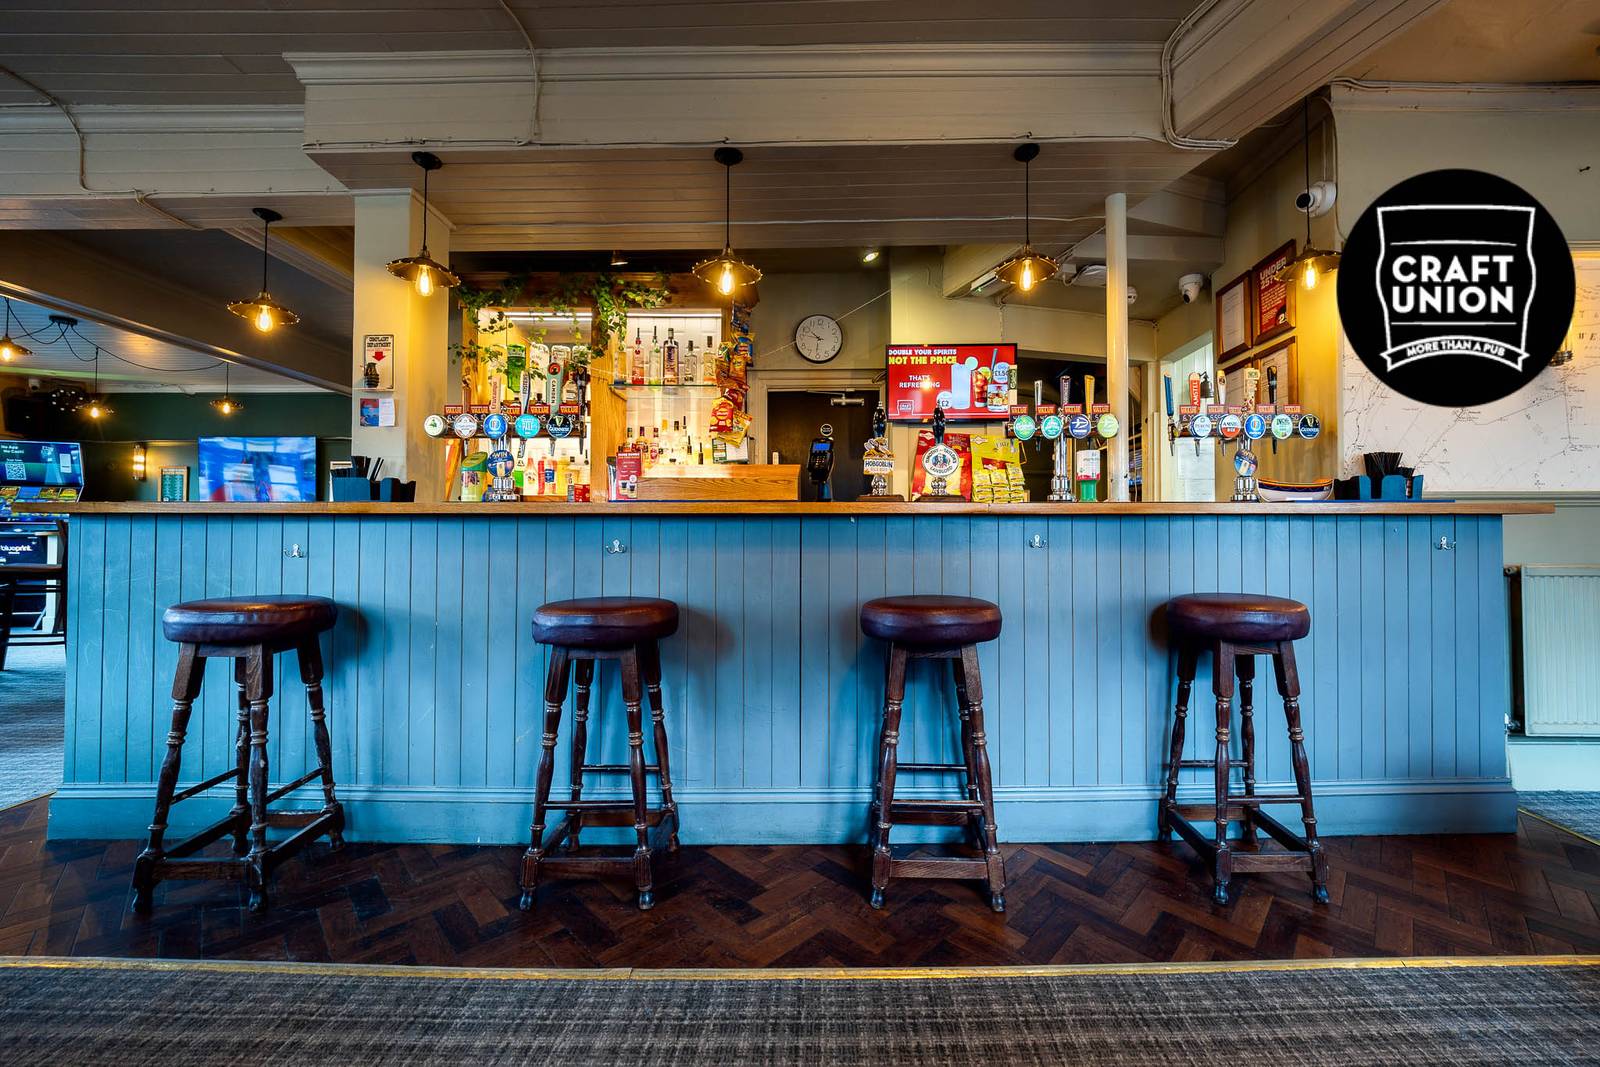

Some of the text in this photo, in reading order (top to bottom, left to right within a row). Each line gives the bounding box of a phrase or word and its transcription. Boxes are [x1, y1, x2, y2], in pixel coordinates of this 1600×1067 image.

[1260, 257, 1287, 280] UNDER
[888, 356, 957, 365] NOT THE PRICE
[1191, 382, 1199, 406] AMSTEL
[530, 406, 550, 414] VALUE
[560, 405, 579, 413] VALUE
[864, 460, 893, 468] HOBGOBLIN
[929, 465, 954, 475] LANDLORD
